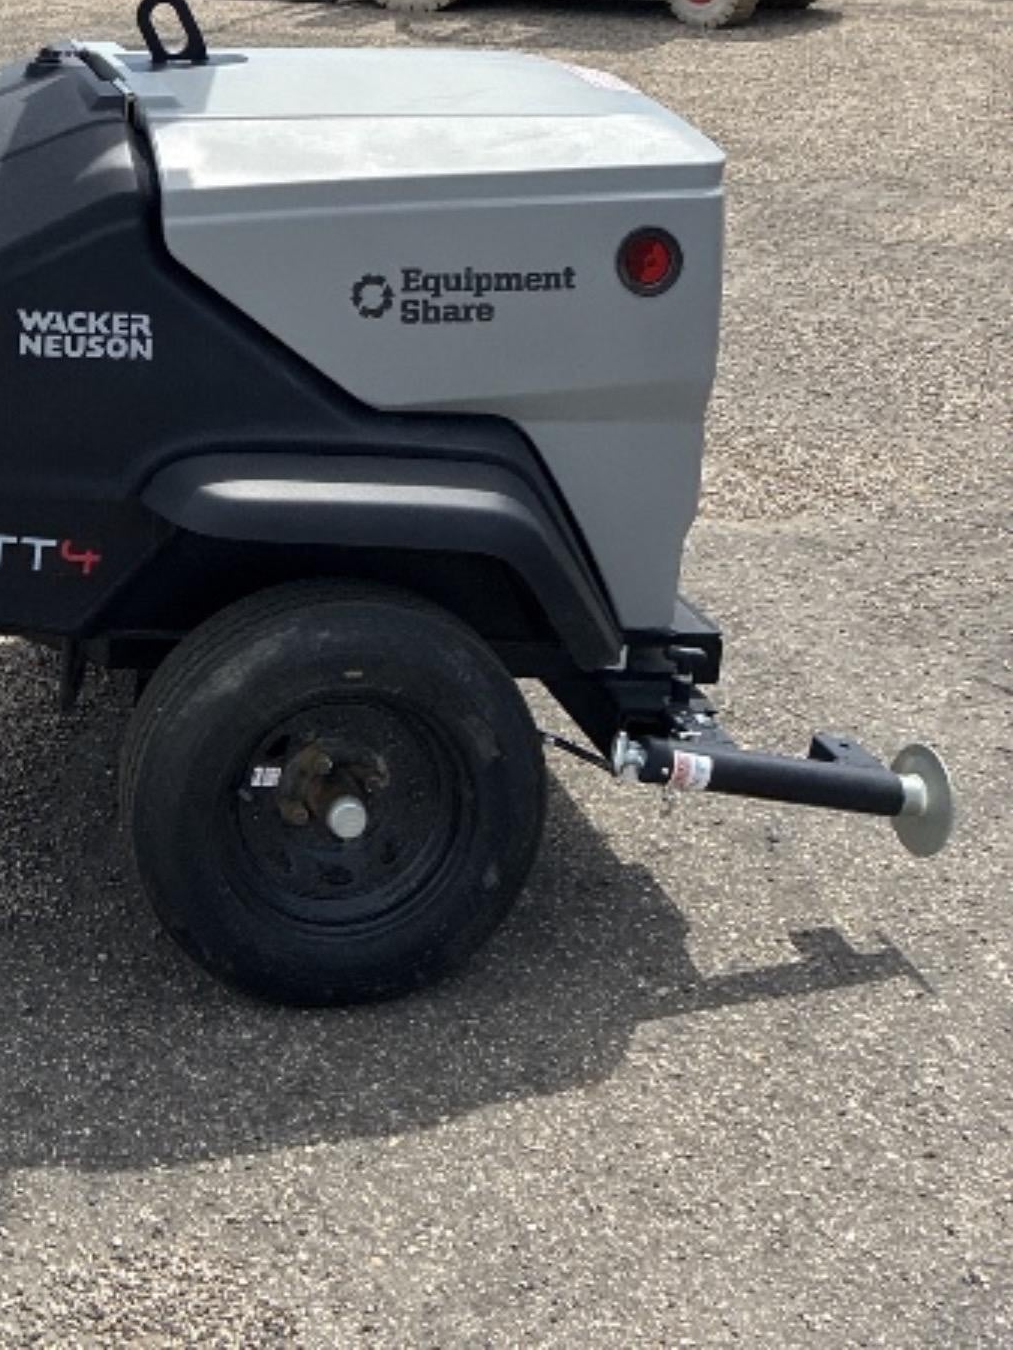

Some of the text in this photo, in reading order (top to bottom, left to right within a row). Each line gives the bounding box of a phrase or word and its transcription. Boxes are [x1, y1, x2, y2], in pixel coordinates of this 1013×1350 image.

[400, 266, 577, 298] Equipment
[17, 308, 152, 337] WACKER
[400, 299, 495, 325] Share
[19, 334, 153, 360] NEUSON
